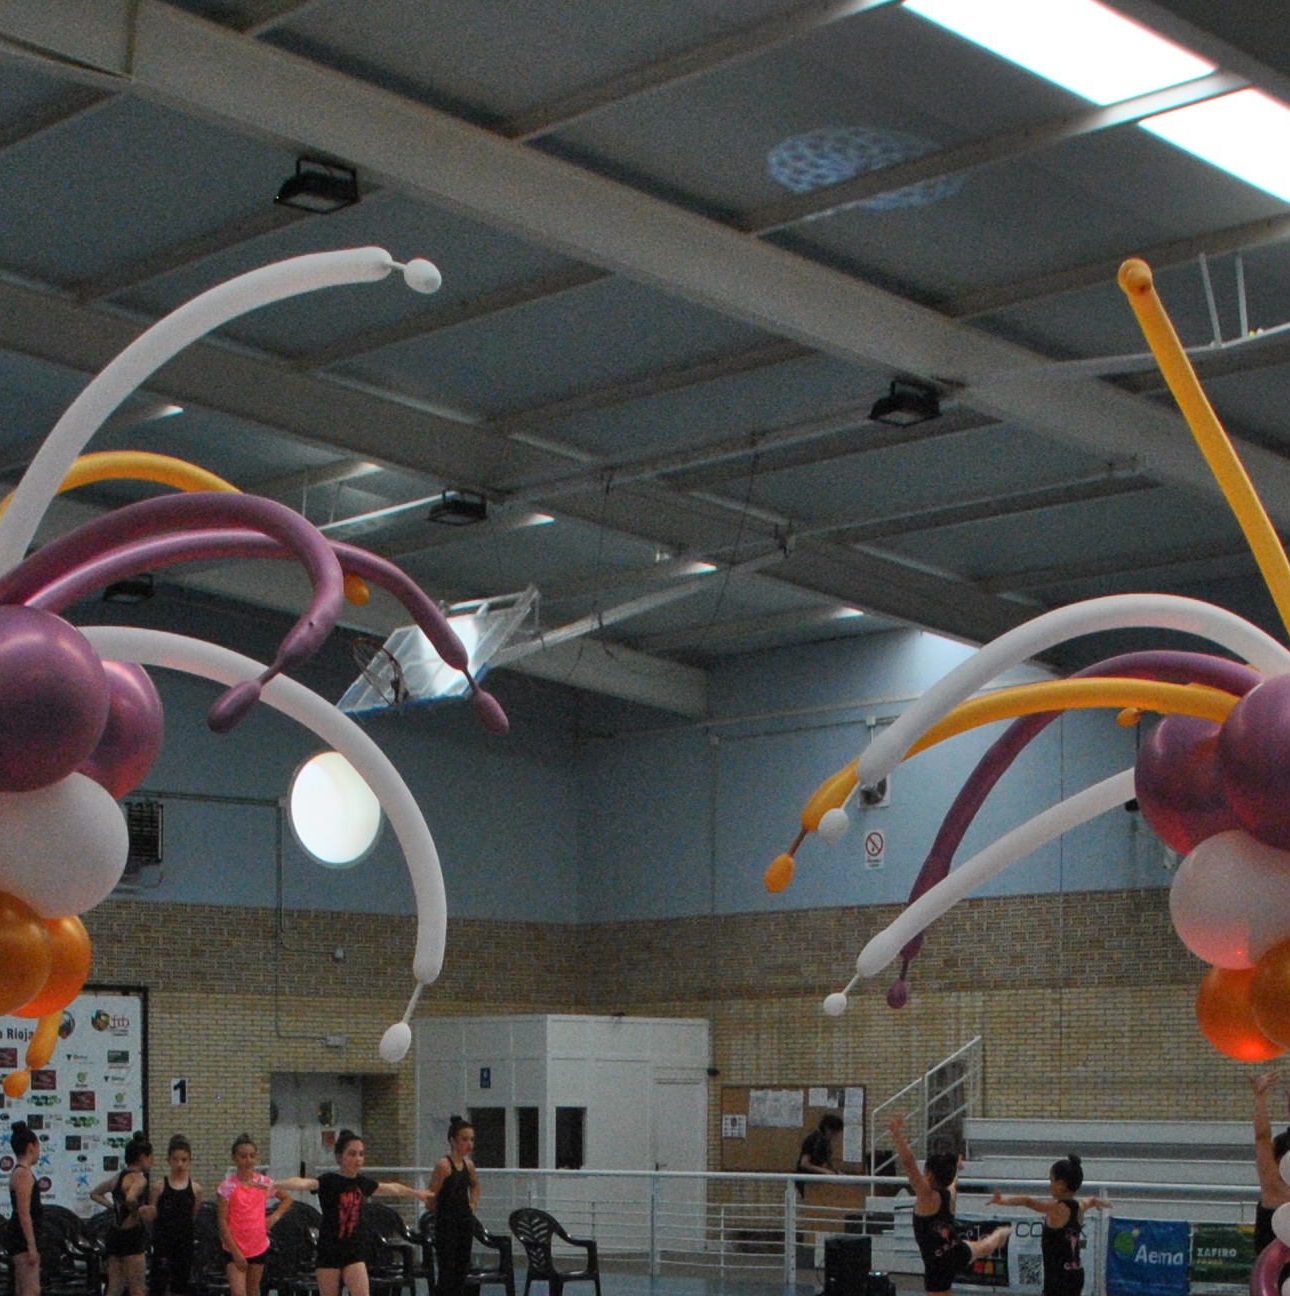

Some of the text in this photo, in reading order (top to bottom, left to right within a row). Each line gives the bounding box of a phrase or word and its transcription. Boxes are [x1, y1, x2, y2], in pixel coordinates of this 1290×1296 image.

[6, 1027, 34, 1042] Rioja
[173, 1079, 187, 1104] 1
[1197, 1247, 1237, 1257] ZAFIRO
